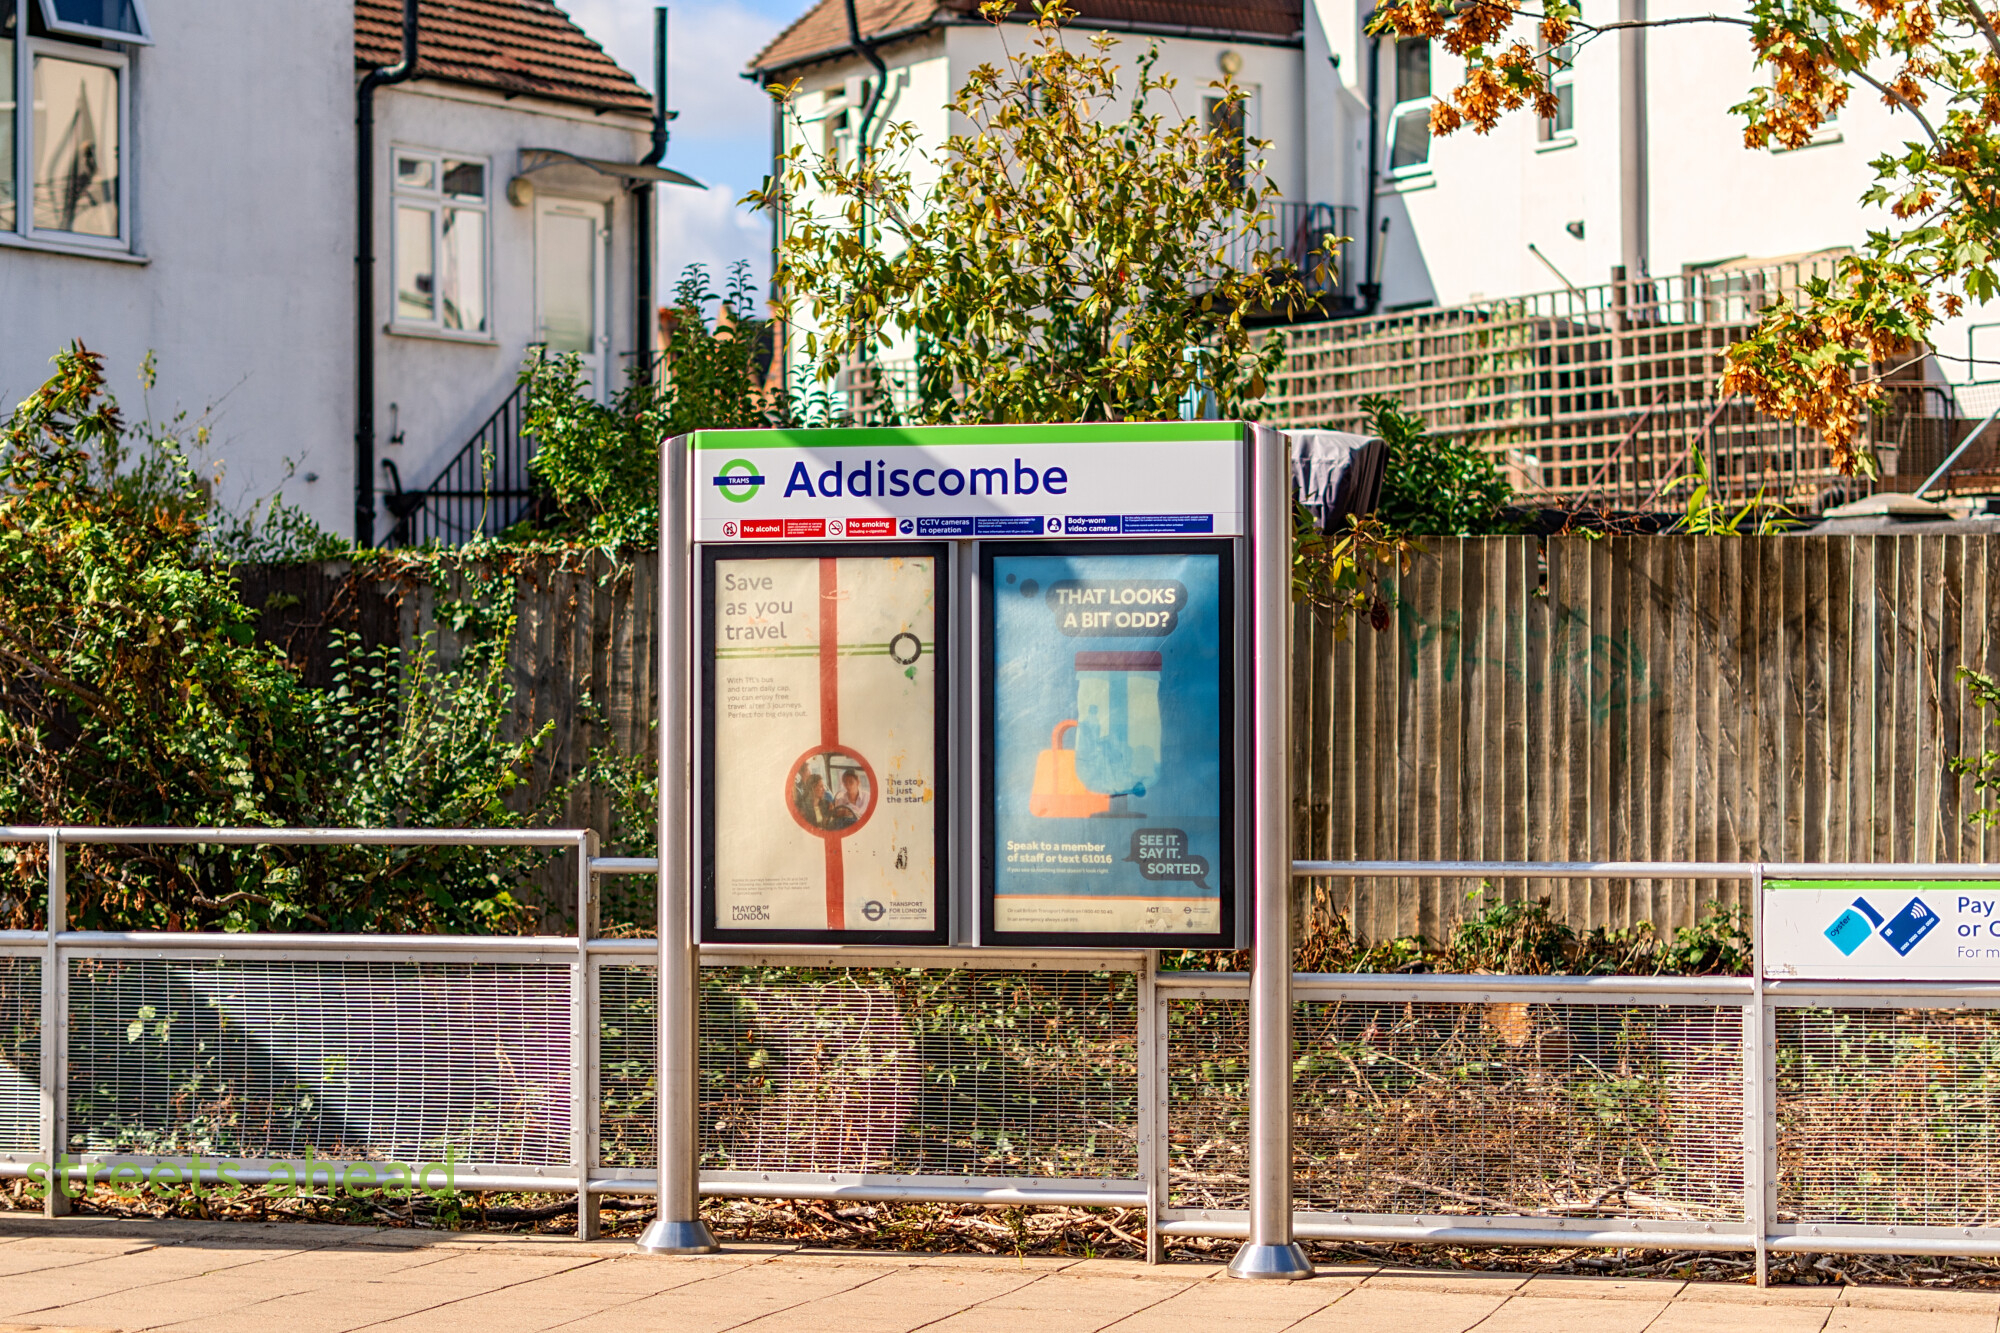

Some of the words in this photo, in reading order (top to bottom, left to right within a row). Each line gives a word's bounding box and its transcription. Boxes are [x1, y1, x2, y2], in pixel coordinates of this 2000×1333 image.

[782, 458, 1068, 499] Addiscombe
[862, 521, 889, 529] smoking
[725, 574, 772, 591] Save
[1056, 588, 1106, 604] THAT
[1110, 588, 1176, 604] LOOKS
[725, 602, 747, 615] as
[755, 601, 792, 619] you
[1063, 612, 1077, 628] A
[1081, 612, 1112, 628] BIT
[1115, 612, 1170, 628] ODD?
[725, 621, 787, 640] travel
[765, 711, 776, 719] big
[904, 778, 924, 787] stop
[896, 787, 913, 796] just
[1007, 840, 1039, 852] Speak
[1040, 842, 1051, 851] to
[1061, 842, 1106, 852] member
[1139, 835, 1163, 846] SEE
[1166, 835, 1180, 846] IT.
[1007, 853, 1019, 862] of
[1020, 853, 1045, 862] staff
[1045, 855, 1056, 863] or
[1058, 854, 1080, 863] text
[1082, 854, 1112, 864] 61016
[1139, 848, 1164, 859] SAY
[1167, 848, 1181, 859] IT.
[1147, 863, 1204, 874] SORTED.
[1958, 896, 1995, 917] Pay
[732, 912, 770, 920] LONDON
[1830, 914, 1851, 937] oyster
[1958, 925, 1981, 937] or
[1958, 946, 1981, 958] For
